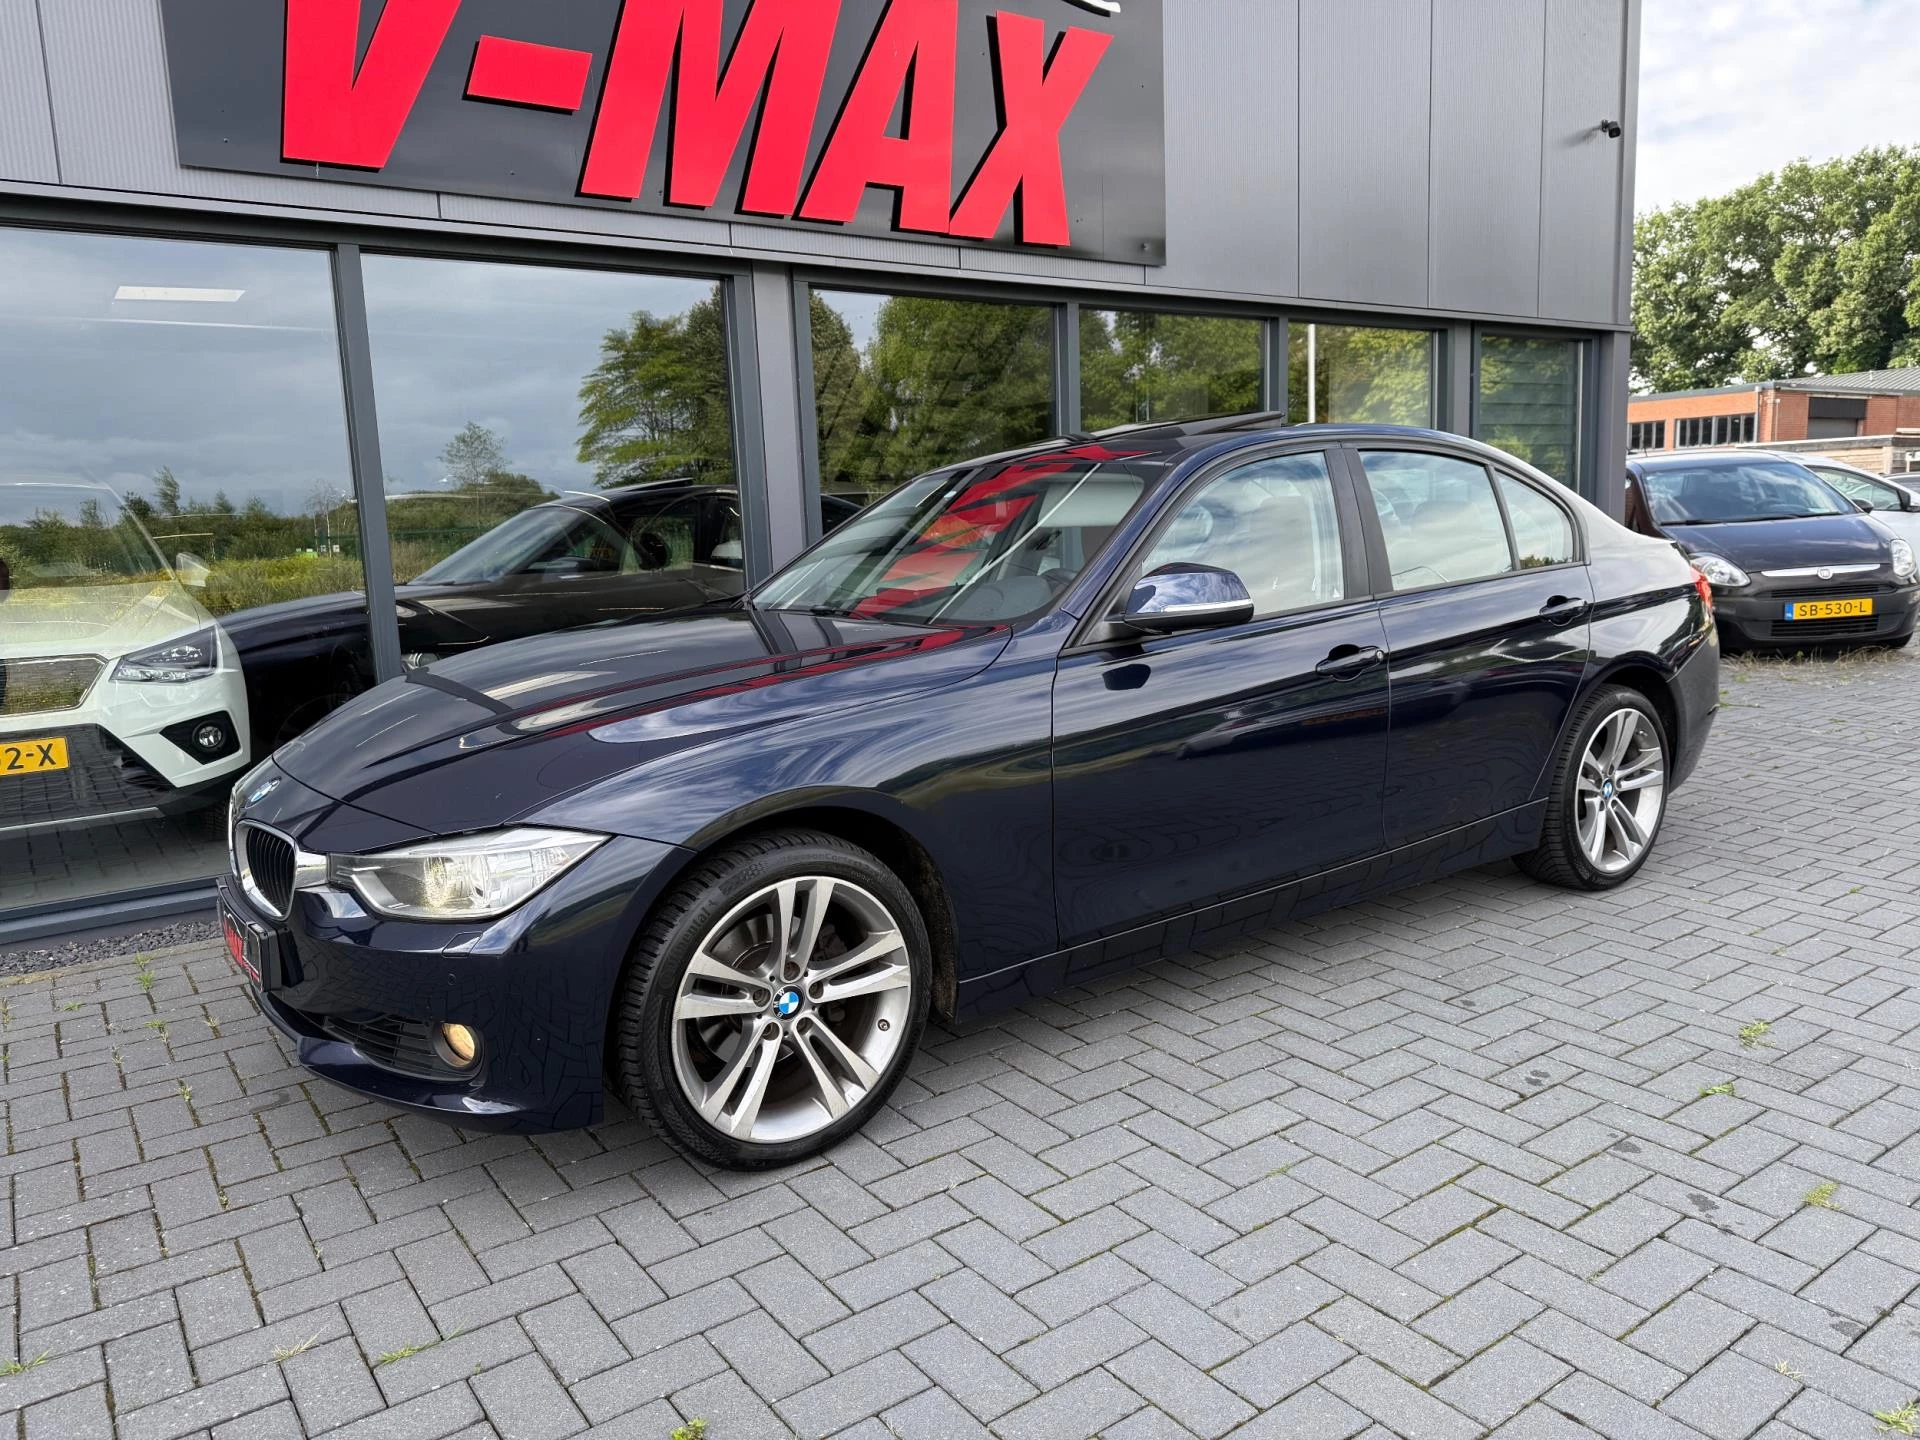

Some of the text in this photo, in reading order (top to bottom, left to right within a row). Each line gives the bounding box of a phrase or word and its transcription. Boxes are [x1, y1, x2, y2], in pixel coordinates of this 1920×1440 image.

[282, 0, 1113, 247] V-MAX
[1799, 601, 1867, 617] SB-530-L
[0, 743, 57, 771] 2-X
